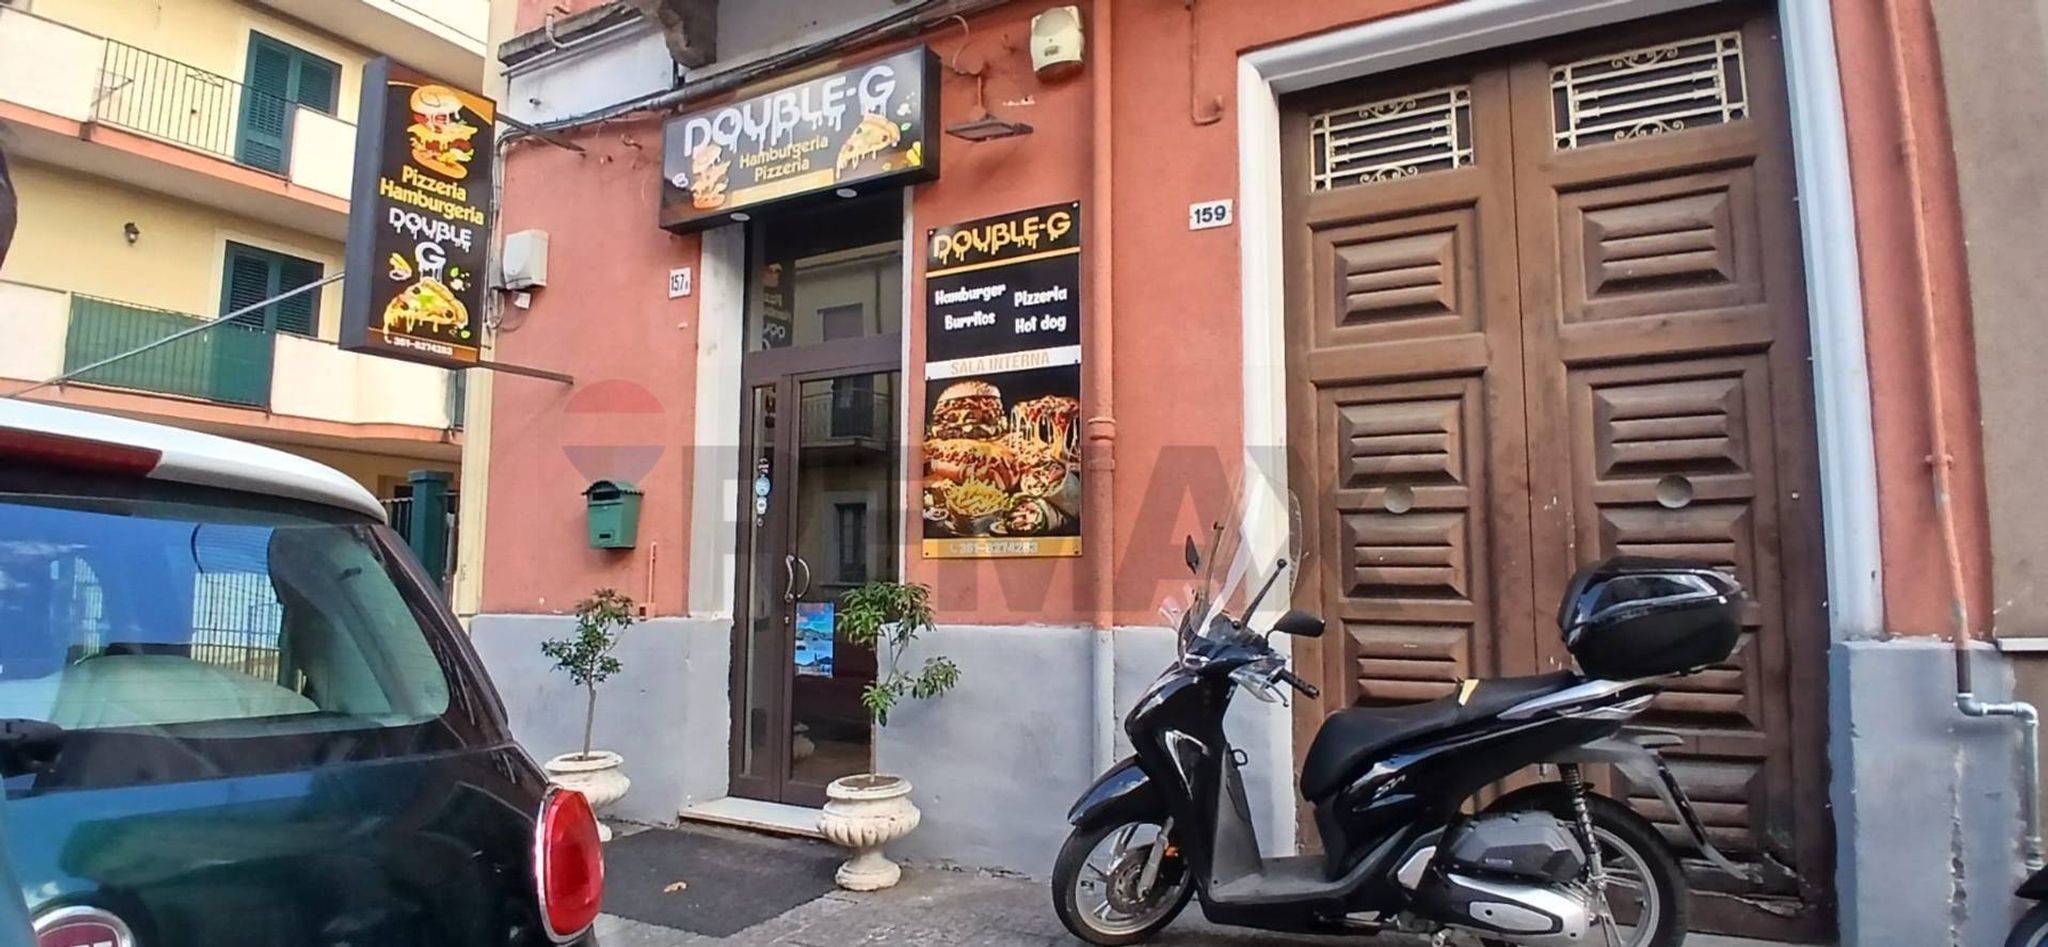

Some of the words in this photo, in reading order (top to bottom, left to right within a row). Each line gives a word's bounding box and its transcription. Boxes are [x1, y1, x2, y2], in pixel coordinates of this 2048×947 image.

[684, 65, 896, 157] DOUBLE-G
[739, 134, 829, 169] Hamburgeria
[401, 165, 467, 202] Pizzeria
[754, 157, 810, 182] Pizzeria
[380, 177, 485, 226] Hamburgeria
[1194, 205, 1226, 224] 159
[389, 207, 473, 252] DOUBLE
[933, 212, 1072, 264] DOUBLE-G
[415, 241, 446, 276] G
[935, 284, 1006, 305] Hamburger
[1014, 285, 1067, 307] Pizzeria
[944, 311, 996, 330] Burritos
[1014, 316, 1037, 334] Hot
[1040, 314, 1067, 331] dog
[950, 357, 988, 376] SALA
[989, 351, 1050, 370] INTERNA
